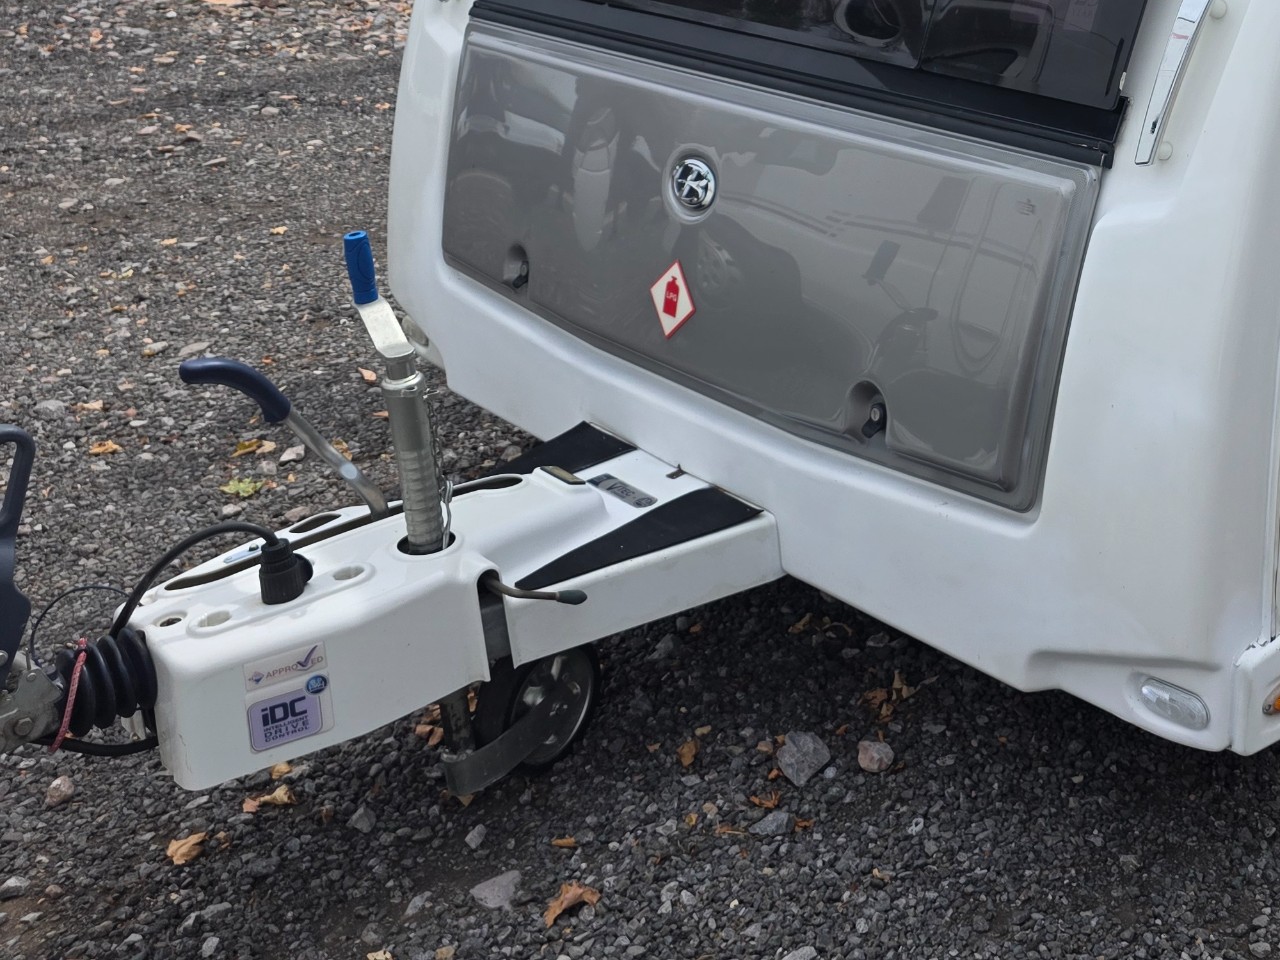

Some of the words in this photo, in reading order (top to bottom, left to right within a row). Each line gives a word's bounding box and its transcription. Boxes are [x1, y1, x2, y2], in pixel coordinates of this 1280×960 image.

[666, 291, 678, 302] LPG
[263, 714, 309, 733] INTELLIGENT
[264, 720, 310, 739] DRIVE
[264, 726, 311, 743] CONTROL
